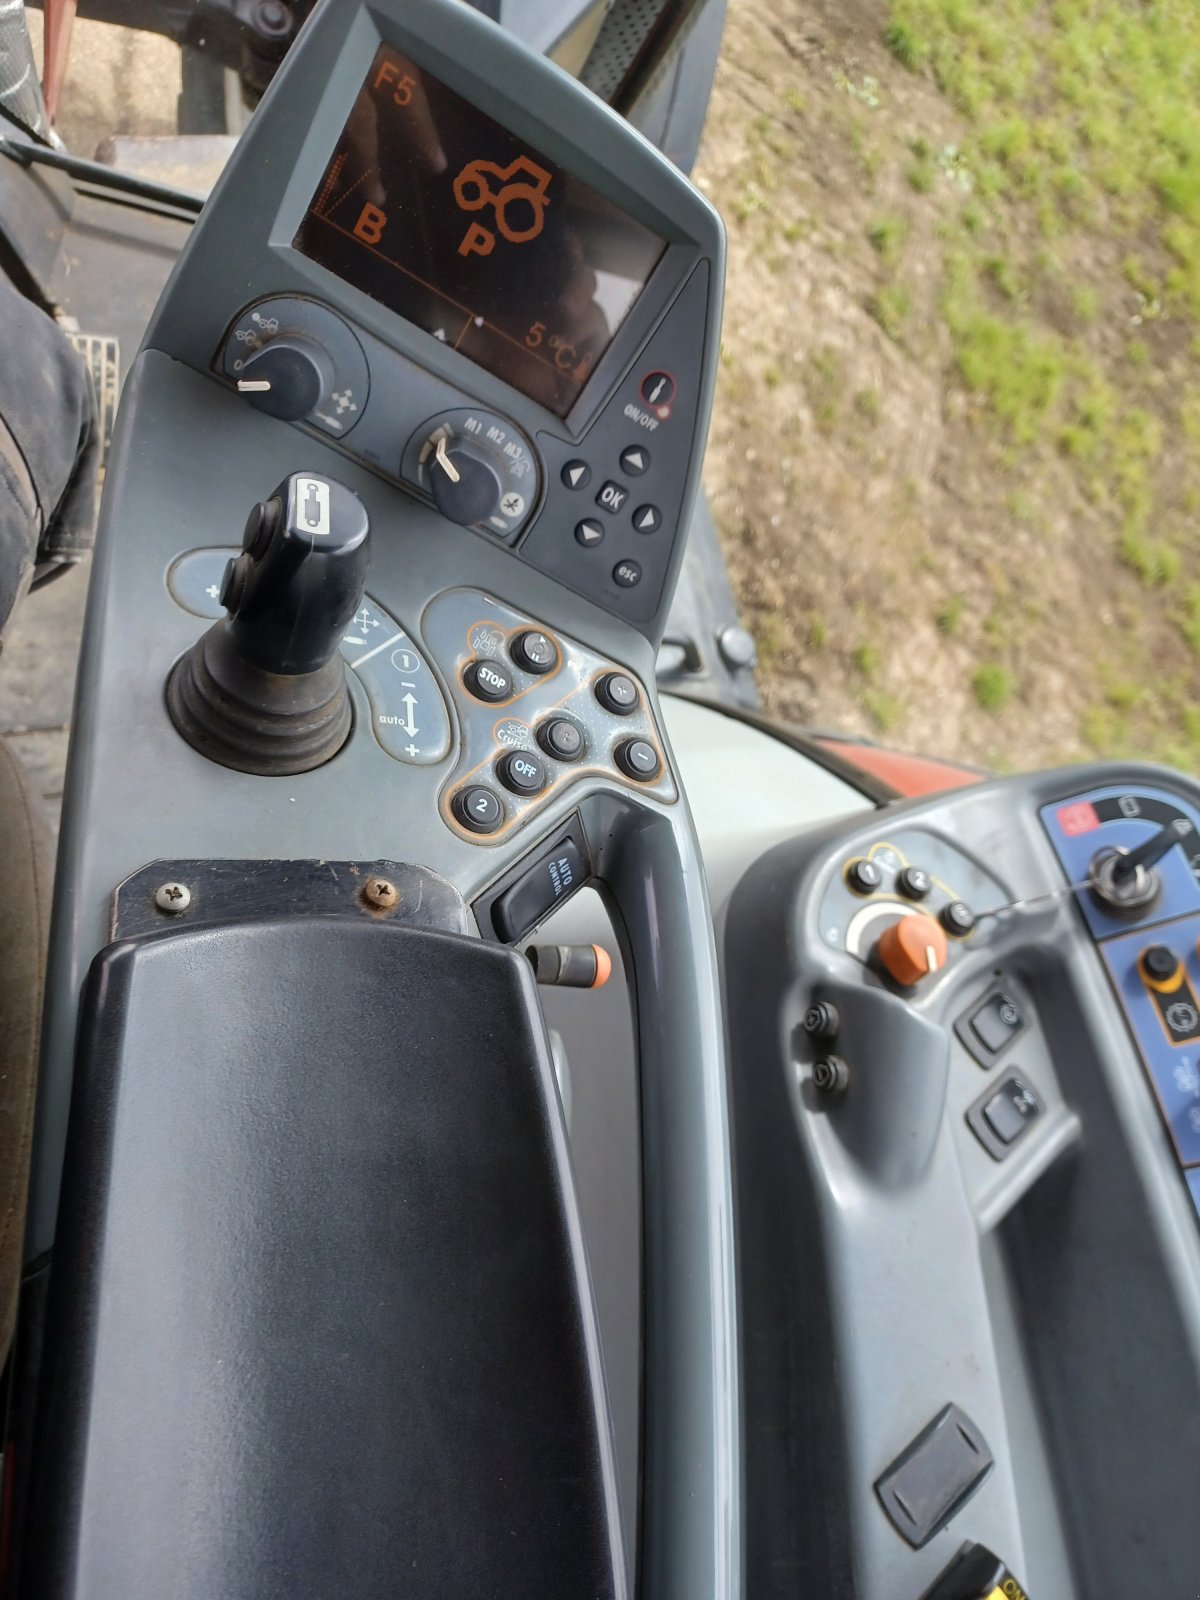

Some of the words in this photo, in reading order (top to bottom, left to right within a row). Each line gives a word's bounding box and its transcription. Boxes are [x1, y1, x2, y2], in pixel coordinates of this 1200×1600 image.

[374, 60, 416, 106] F5
[353, 202, 388, 244] B
[458, 223, 495, 257] P
[525, 321, 546, 348] 5
[464, 416, 484, 434] M1
[624, 403, 659, 431] ON/OFF
[486, 426, 505, 445] M2
[601, 488, 624, 508] OK
[618, 565, 638, 582] esc
[479, 667, 506, 689] STOP
[379, 714, 405, 726] auto
[497, 728, 531, 751] Cruise
[514, 761, 537, 777] OFF
[476, 799, 488, 813] 2
[548, 861, 563, 896] CONTROL
[557, 857, 573, 886] AUTO
[864, 864, 875, 880] 1
[914, 871, 926, 888] 2
